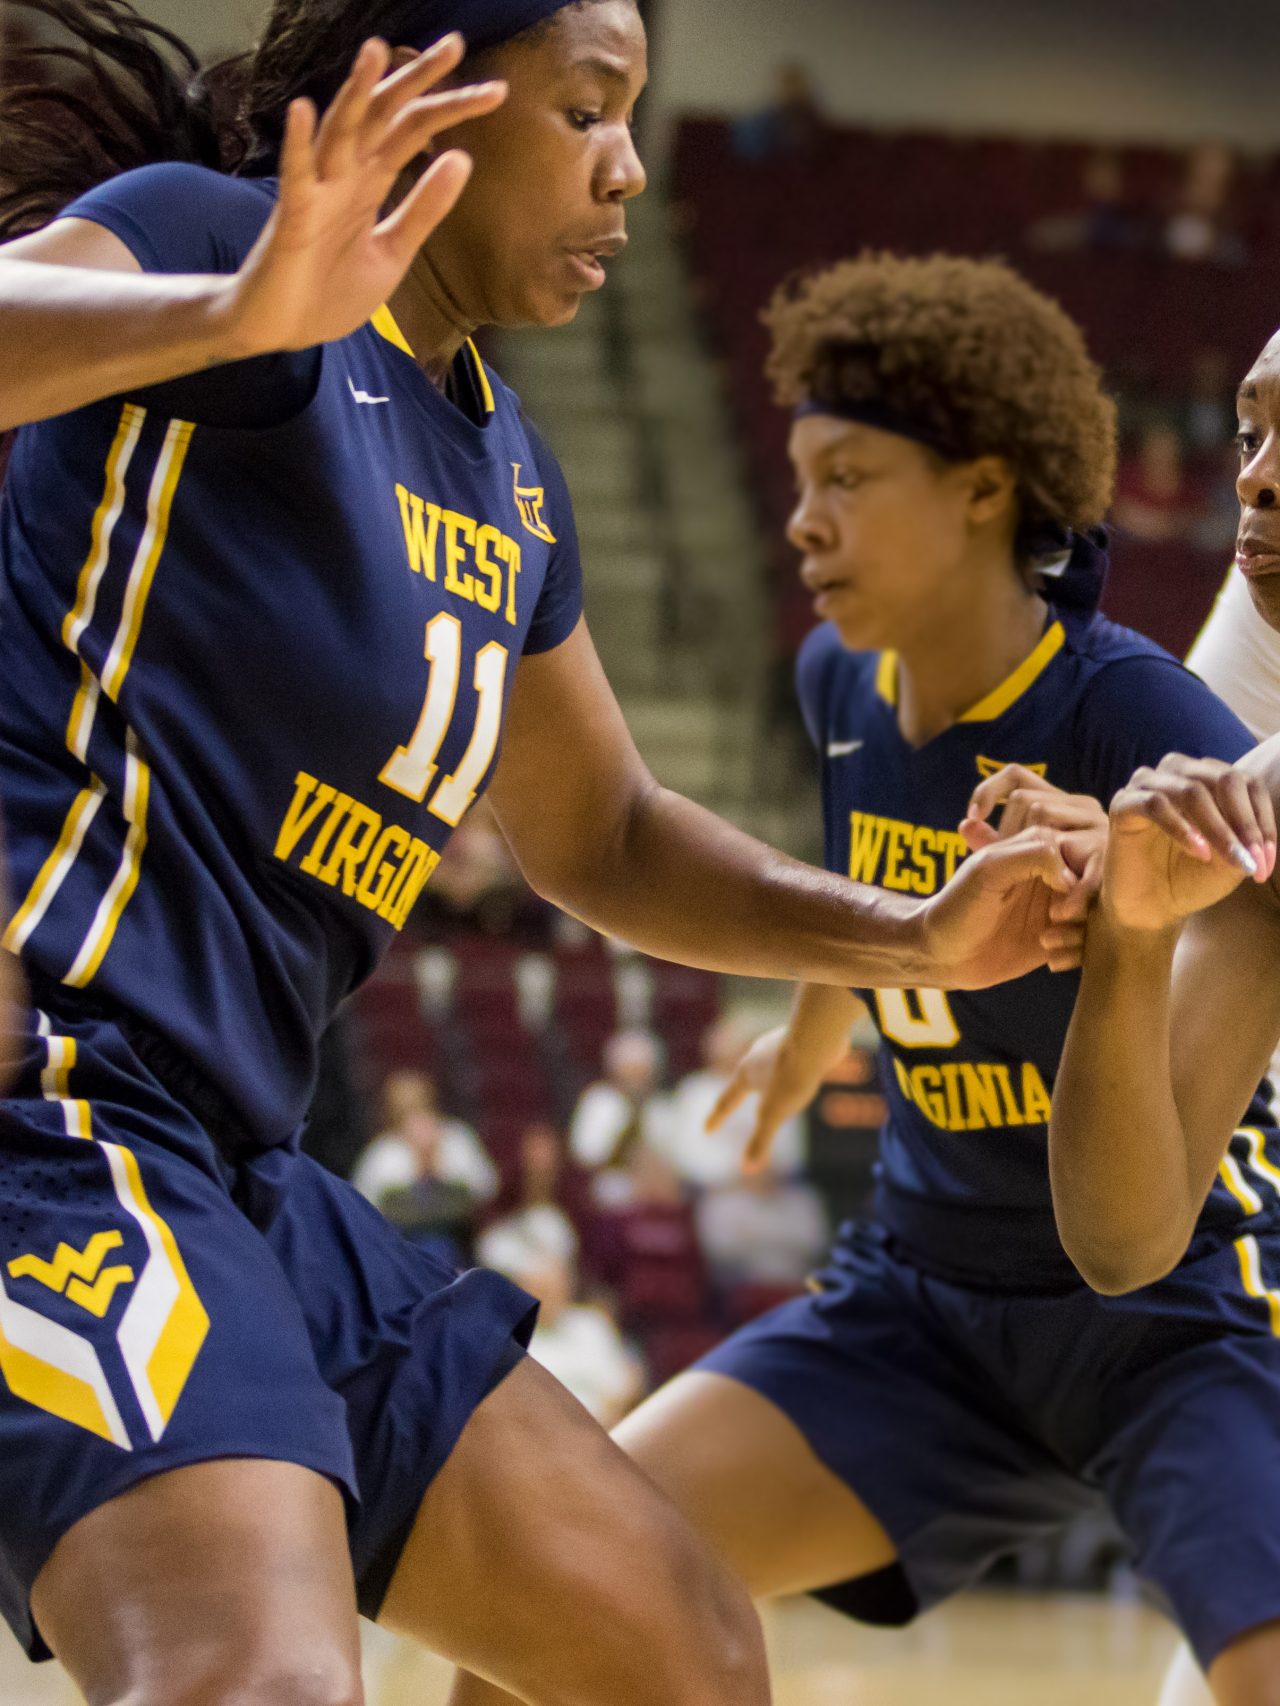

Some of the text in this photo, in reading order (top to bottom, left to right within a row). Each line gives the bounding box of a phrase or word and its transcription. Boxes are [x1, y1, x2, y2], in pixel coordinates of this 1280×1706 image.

[394, 482, 522, 626] WEST
[377, 610, 509, 828] 11
[850, 810, 967, 895] WEST
